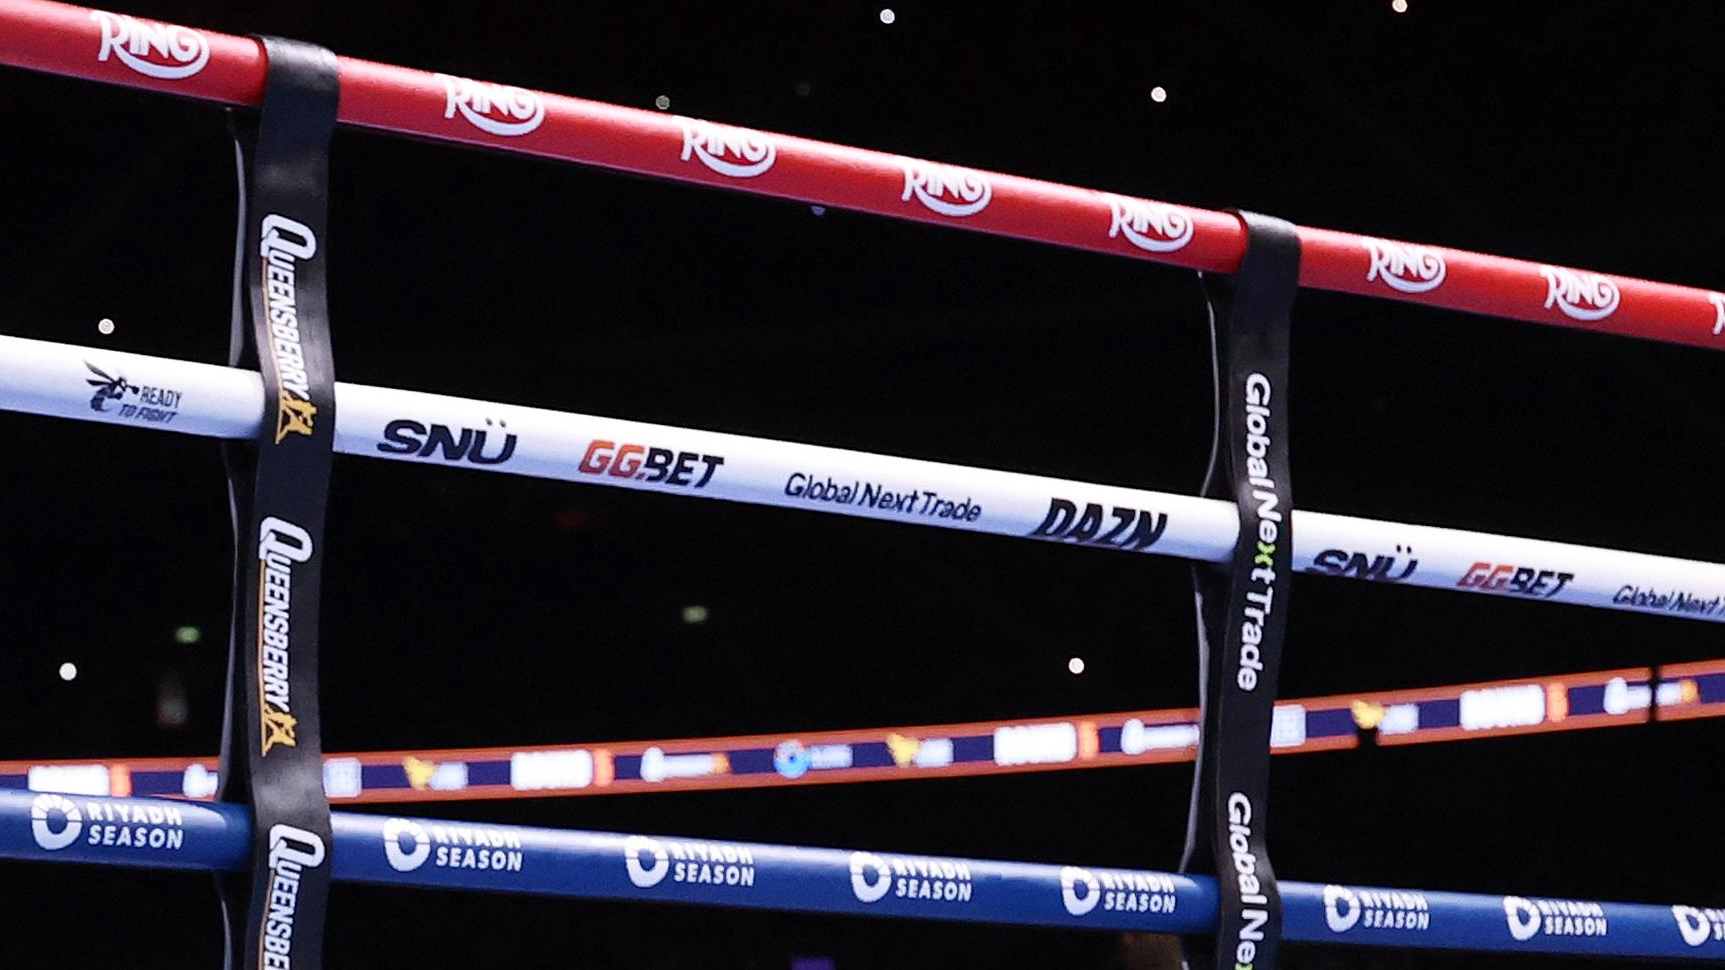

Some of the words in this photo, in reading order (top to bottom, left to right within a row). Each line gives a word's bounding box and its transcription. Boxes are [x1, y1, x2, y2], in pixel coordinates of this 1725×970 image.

[91, 10, 210, 79] RING
[435, 73, 545, 136] RING
[673, 115, 777, 177] RING
[896, 156, 992, 216] RING
[1103, 192, 1194, 252] RING
[1362, 236, 1446, 293] RING
[1540, 265, 1620, 321] RING
[260, 213, 317, 401] QUEENSBERRY
[140, 385, 183, 409] READY
[1245, 372, 1275, 489] Global
[784, 473, 860, 505] Global
[857, 484, 919, 515] Next
[917, 491, 982, 522] Trade
[1026, 498, 1169, 550] DAZN
[1250, 489, 1282, 584] Next
[258, 516, 313, 712] QUEENSBERRY
[1236, 588, 1274, 692] Trade
[87, 825, 184, 850] SEASON
[88, 802, 183, 827] RIYADH
[435, 846, 523, 872] SEASON
[673, 863, 756, 887] SEASON
[1226, 792, 1269, 905] Global
[895, 878, 973, 902] SEASON
[1104, 892, 1177, 914] SEASON
